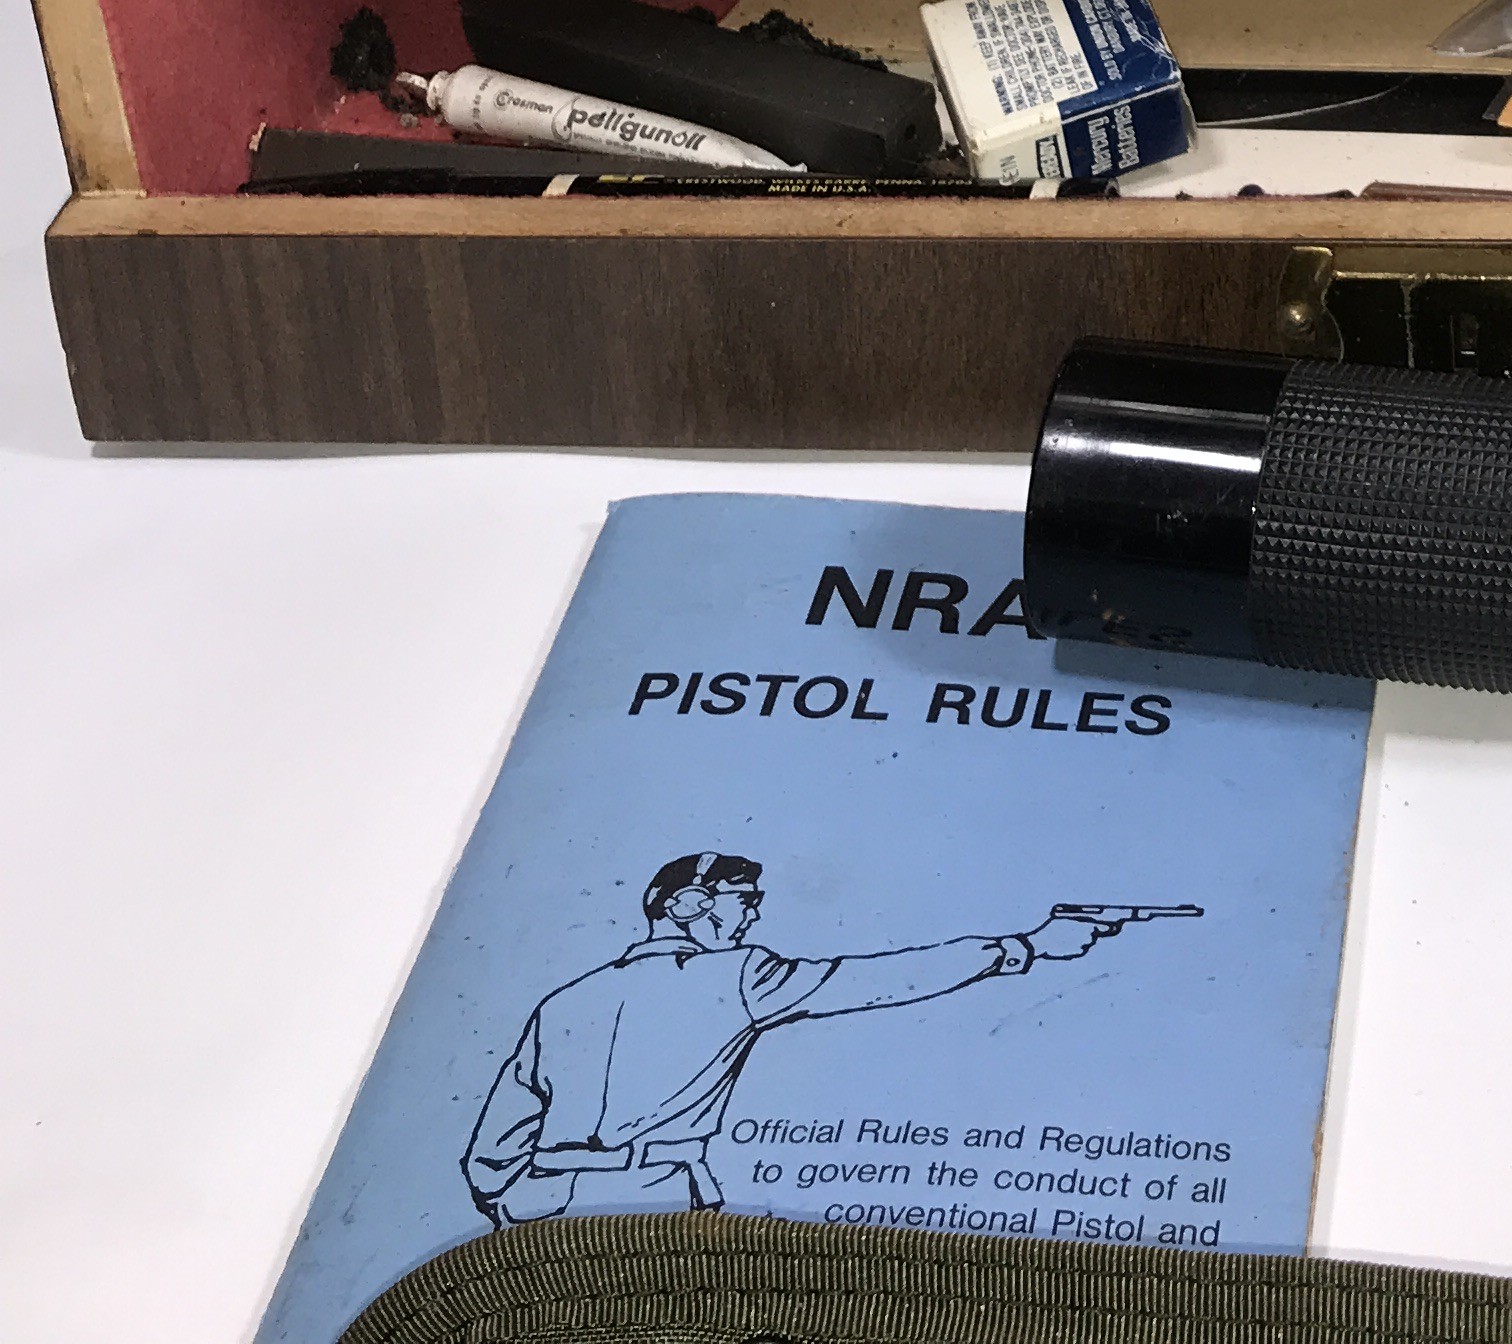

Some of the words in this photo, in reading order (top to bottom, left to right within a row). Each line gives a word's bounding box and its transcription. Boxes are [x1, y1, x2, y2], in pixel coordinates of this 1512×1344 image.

[493, 87, 555, 115] Crosman
[1087, 116, 1114, 176] Mercury
[1113, 105, 1139, 169] Batteries
[768, 185, 807, 194] MADE
[811, 185, 827, 194] IN
[831, 185, 872, 194] U.S.A.
[804, 565, 1048, 641] NRA
[626, 670, 891, 722] PISTOL
[925, 683, 1175, 737] RULES
[731, 1117, 845, 1145] Official
[856, 1117, 951, 1148] Rules
[962, 1123, 1024, 1151] and
[1038, 1125, 1232, 1164] Regulations
[751, 1158, 783, 1186] to
[796, 1160, 911, 1189] govern
[926, 1160, 979, 1188] the
[993, 1164, 1132, 1199] conduct
[1144, 1175, 1180, 1203] of
[1190, 1177, 1228, 1204] all
[823, 1198, 1037, 1235] conventional
[1051, 1209, 1144, 1242] Pistol
[1157, 1219, 1221, 1247] and
